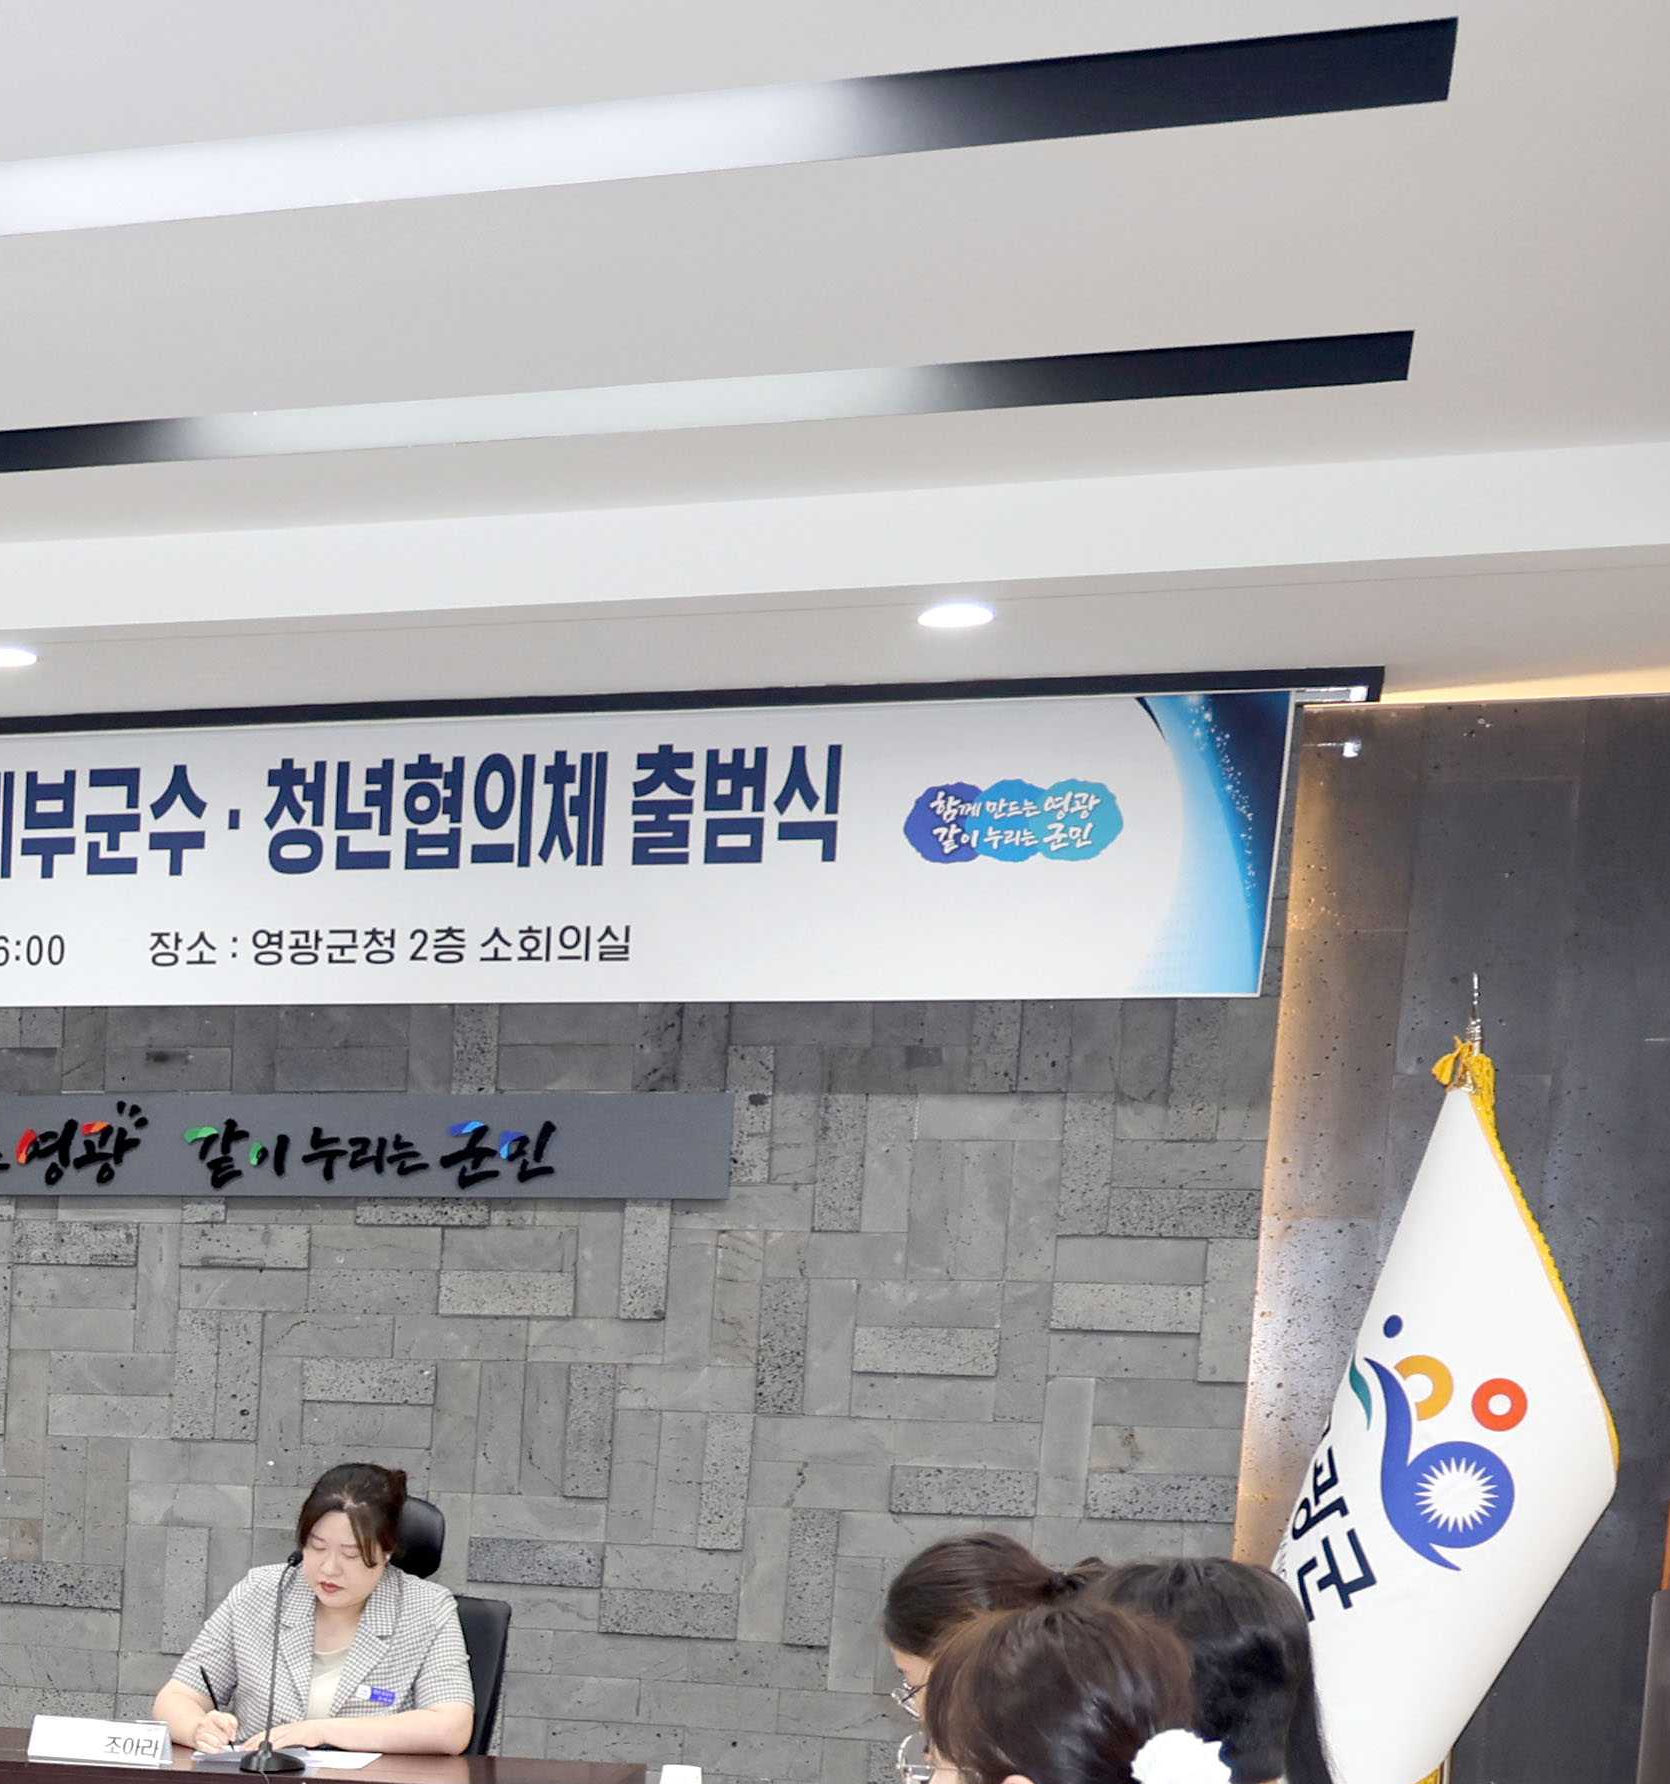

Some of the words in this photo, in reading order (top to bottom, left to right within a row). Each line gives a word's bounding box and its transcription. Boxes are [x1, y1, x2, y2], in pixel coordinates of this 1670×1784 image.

[263, 749, 609, 875] 청년협의체
[631, 743, 843, 866] 출범식
[929, 790, 982, 823] 함께
[985, 797, 1041, 820] 만드는
[1044, 791, 1101, 820] 영광
[932, 821, 980, 854] 같이
[983, 825, 1039, 850] 누리는
[1043, 821, 1094, 851] 군민
[252, 927, 396, 966] 영광군청
[409, 926, 466, 964] 2층
[479, 925, 631, 963] 소회의실
[16, 1117, 144, 1186] 영광
[183, 1117, 291, 1189] 같이
[301, 1126, 429, 1182] 누리는
[440, 1119, 558, 1190] 군민
[1291, 1414, 1378, 1623] 광군
[103, 1735, 160, 1759] 조아라
